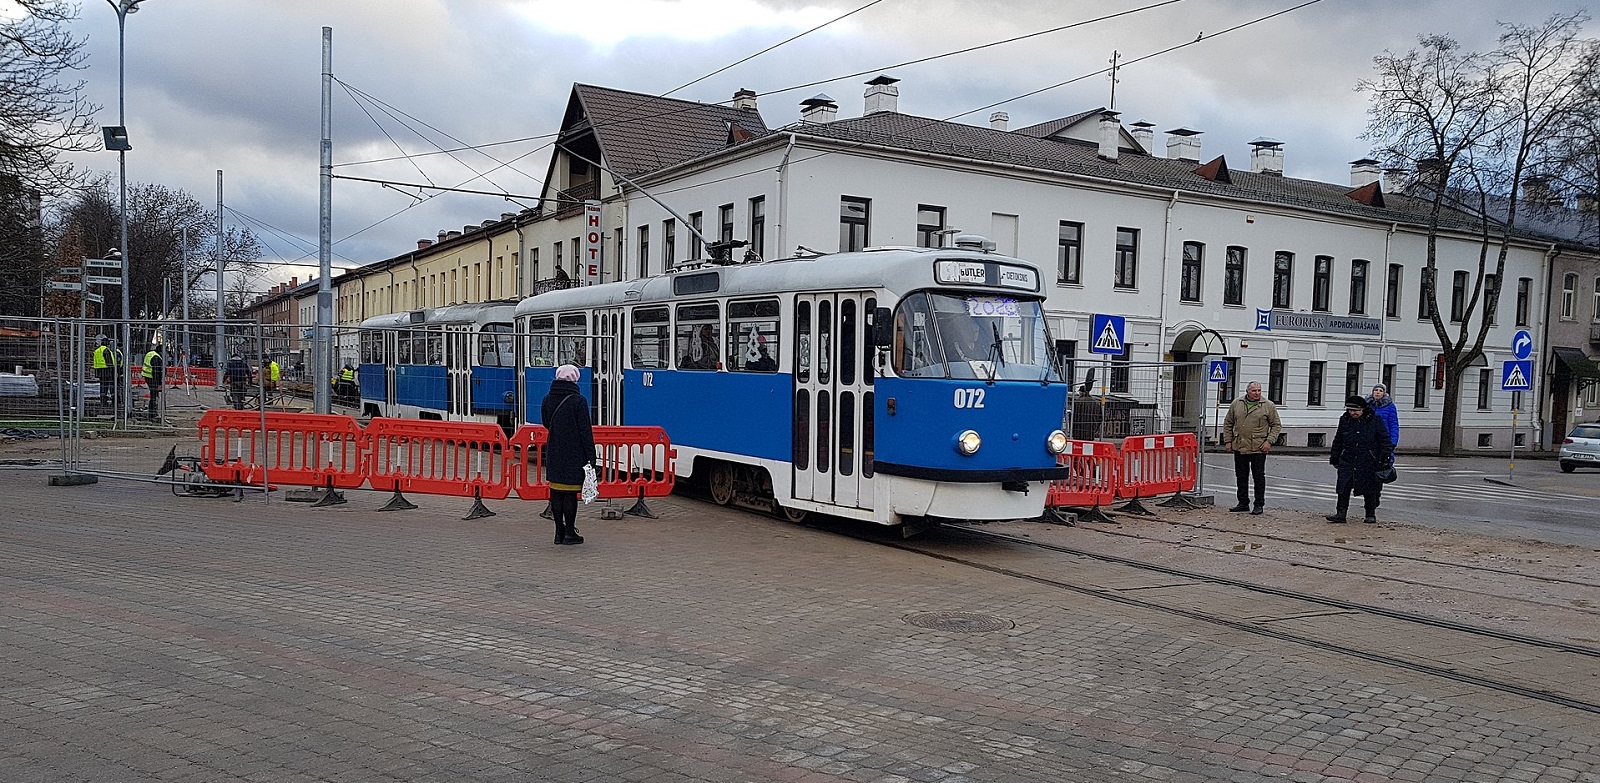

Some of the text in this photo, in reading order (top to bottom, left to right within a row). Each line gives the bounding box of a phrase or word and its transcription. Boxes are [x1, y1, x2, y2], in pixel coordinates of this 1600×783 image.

[1275, 315, 1324, 329] EURORISK
[642, 372, 654, 387] 072
[954, 388, 986, 409] 072
